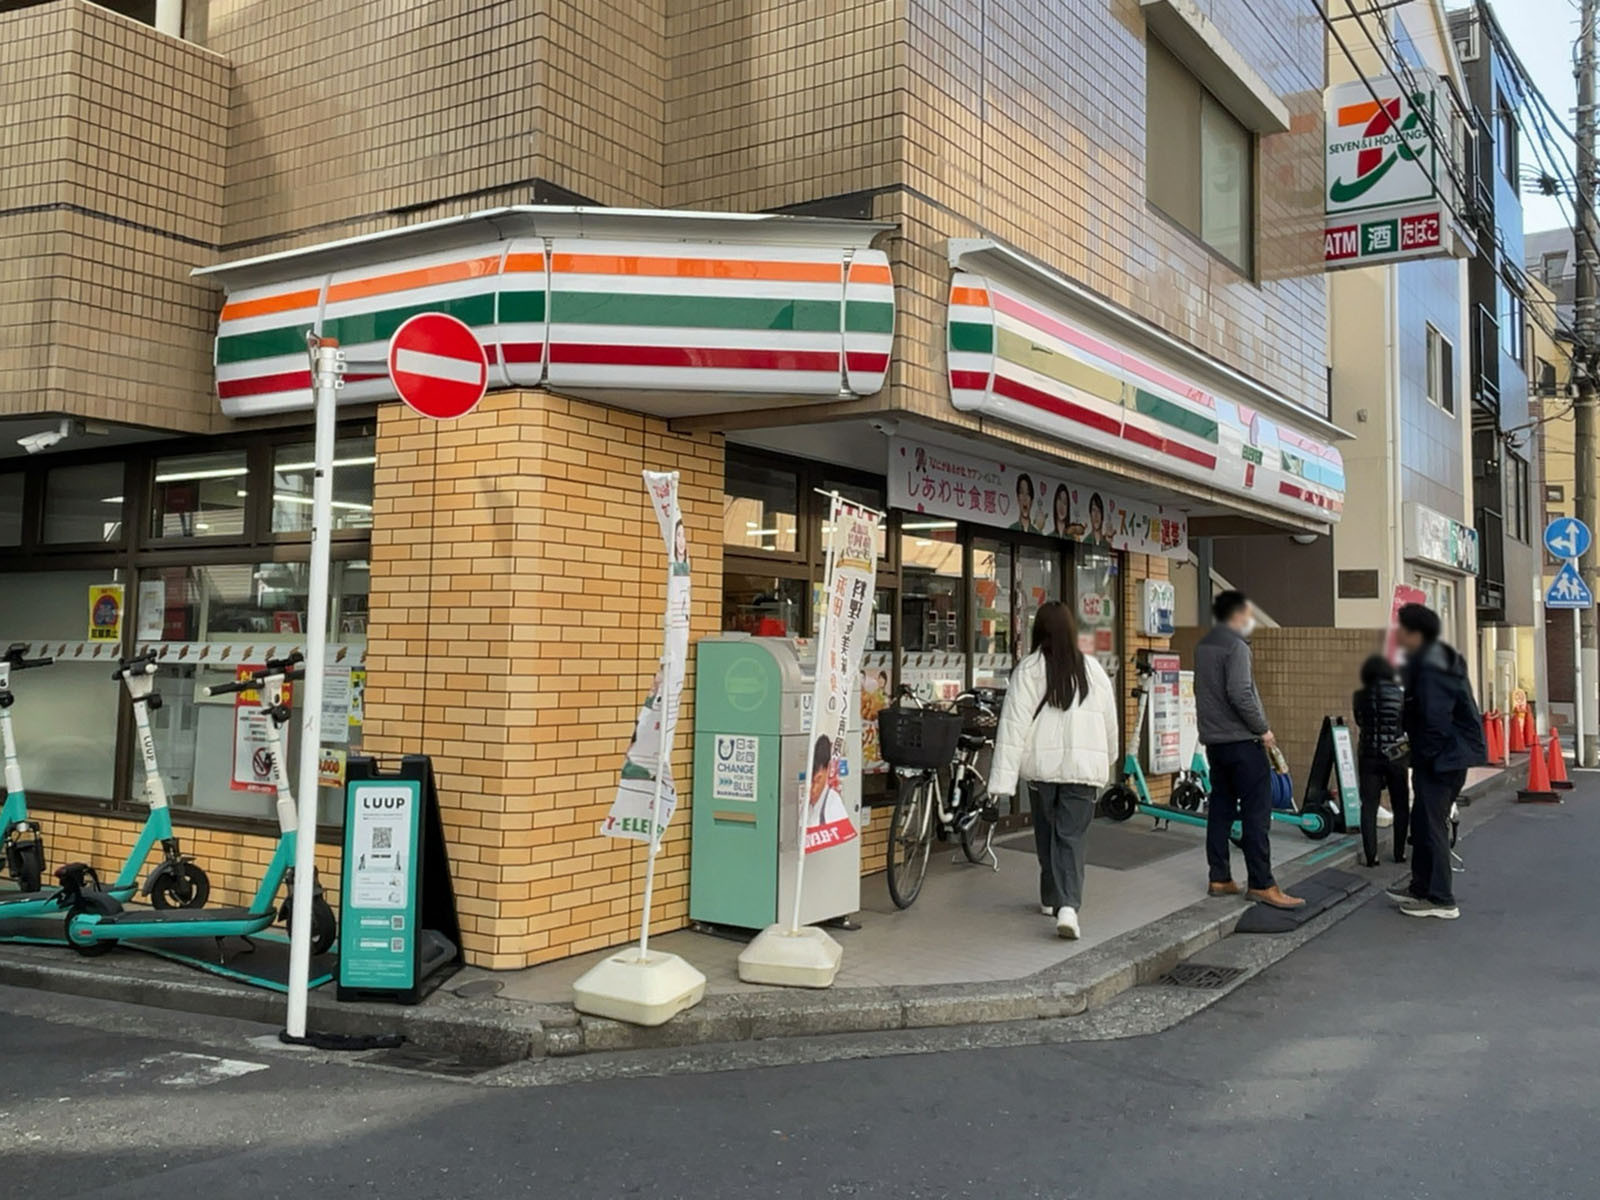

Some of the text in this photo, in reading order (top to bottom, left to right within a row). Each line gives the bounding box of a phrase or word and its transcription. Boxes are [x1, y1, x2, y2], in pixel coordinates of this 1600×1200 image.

[1375, 129, 1428, 146] HOLDNGS
[1367, 224, 1392, 252] 酒
[1402, 218, 1439, 245] たばこ
[1325, 229, 1357, 257] ATM
[144, 735, 154, 761] LUUP
[736, 738, 756, 750] 日本
[717, 763, 755, 775] CHANGE
[733, 781, 753, 792] BLUE
[363, 797, 406, 809] LUUP
